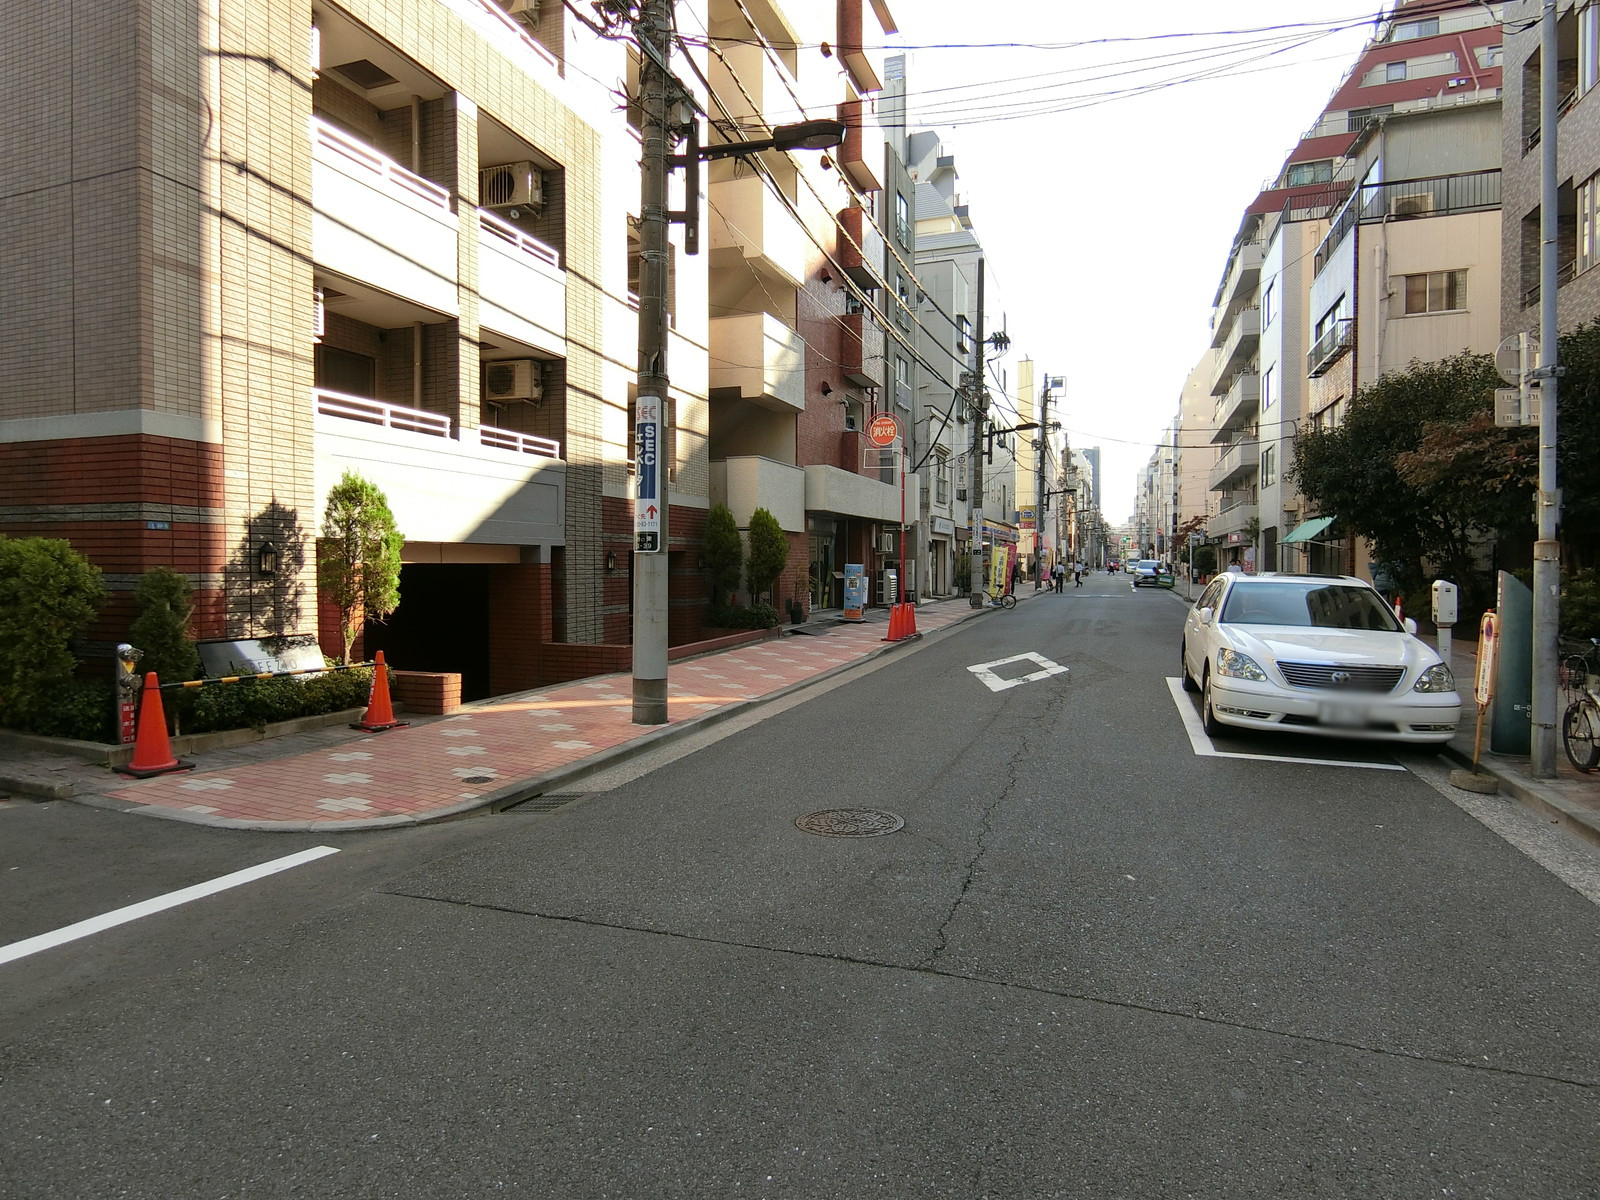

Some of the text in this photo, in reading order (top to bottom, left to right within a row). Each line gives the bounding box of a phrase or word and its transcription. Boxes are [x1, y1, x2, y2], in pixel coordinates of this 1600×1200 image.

[873, 425, 895, 437] 消火栓
[644, 425, 655, 466] SEC
